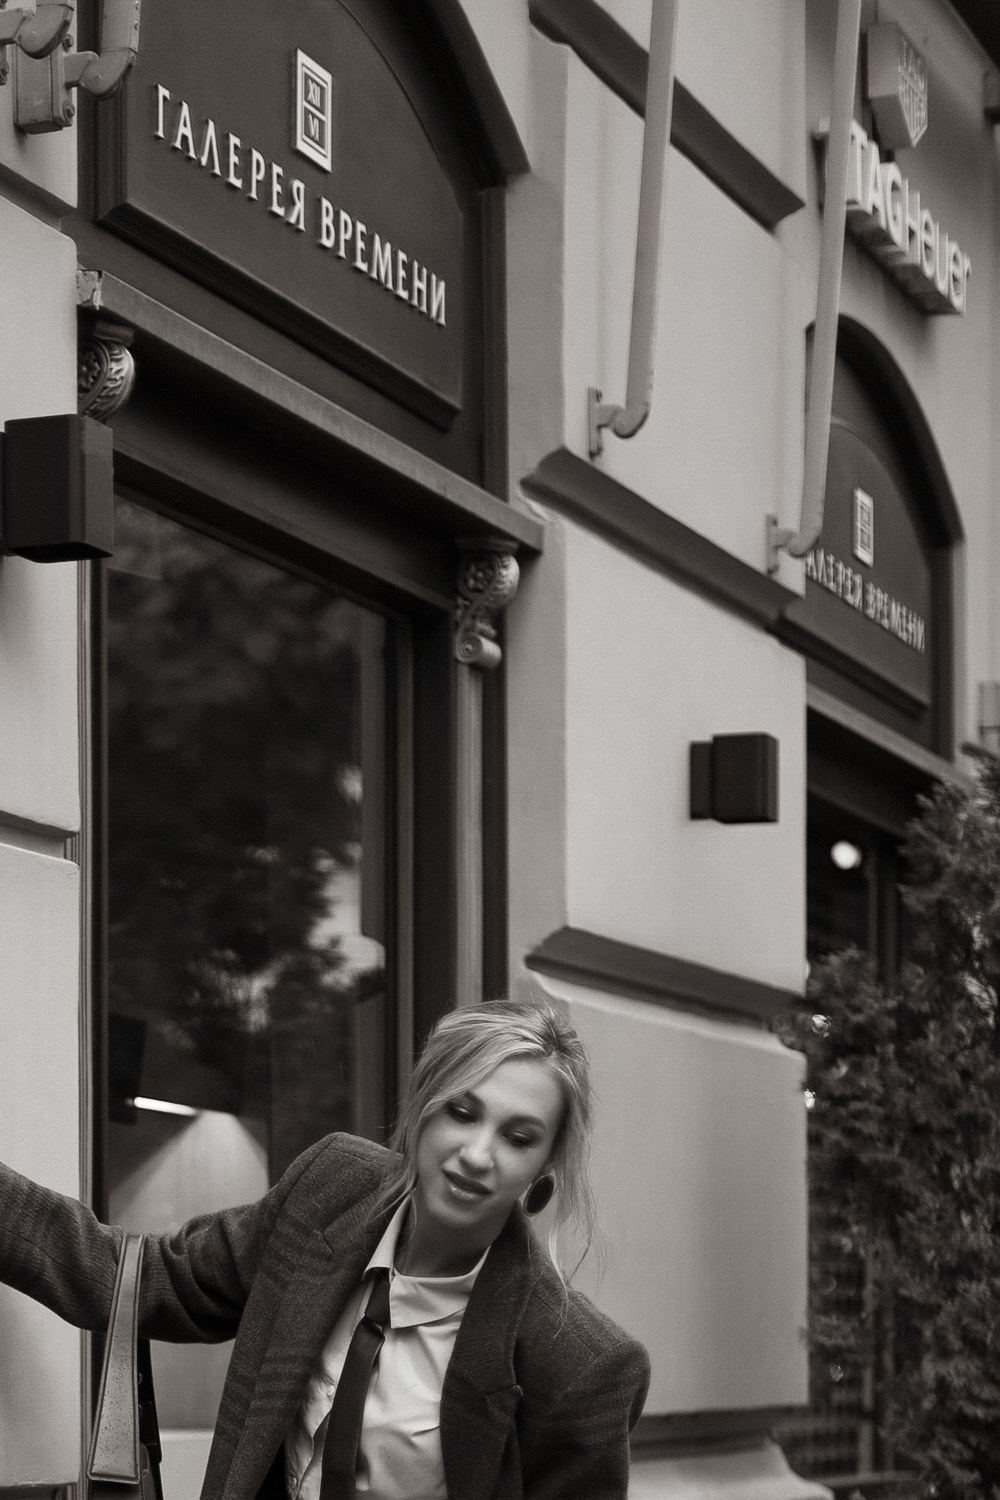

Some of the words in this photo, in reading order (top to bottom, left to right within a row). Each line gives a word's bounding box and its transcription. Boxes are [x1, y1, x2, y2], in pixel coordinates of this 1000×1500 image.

[154, 83, 307, 232] ГАЛЕРЕЯ
[318, 195, 447, 327] ВРЕМЕНИ
[806, 548, 863, 612] АЛЕРЕЯ
[864, 582, 926, 655] ВРЕМЕНИ
